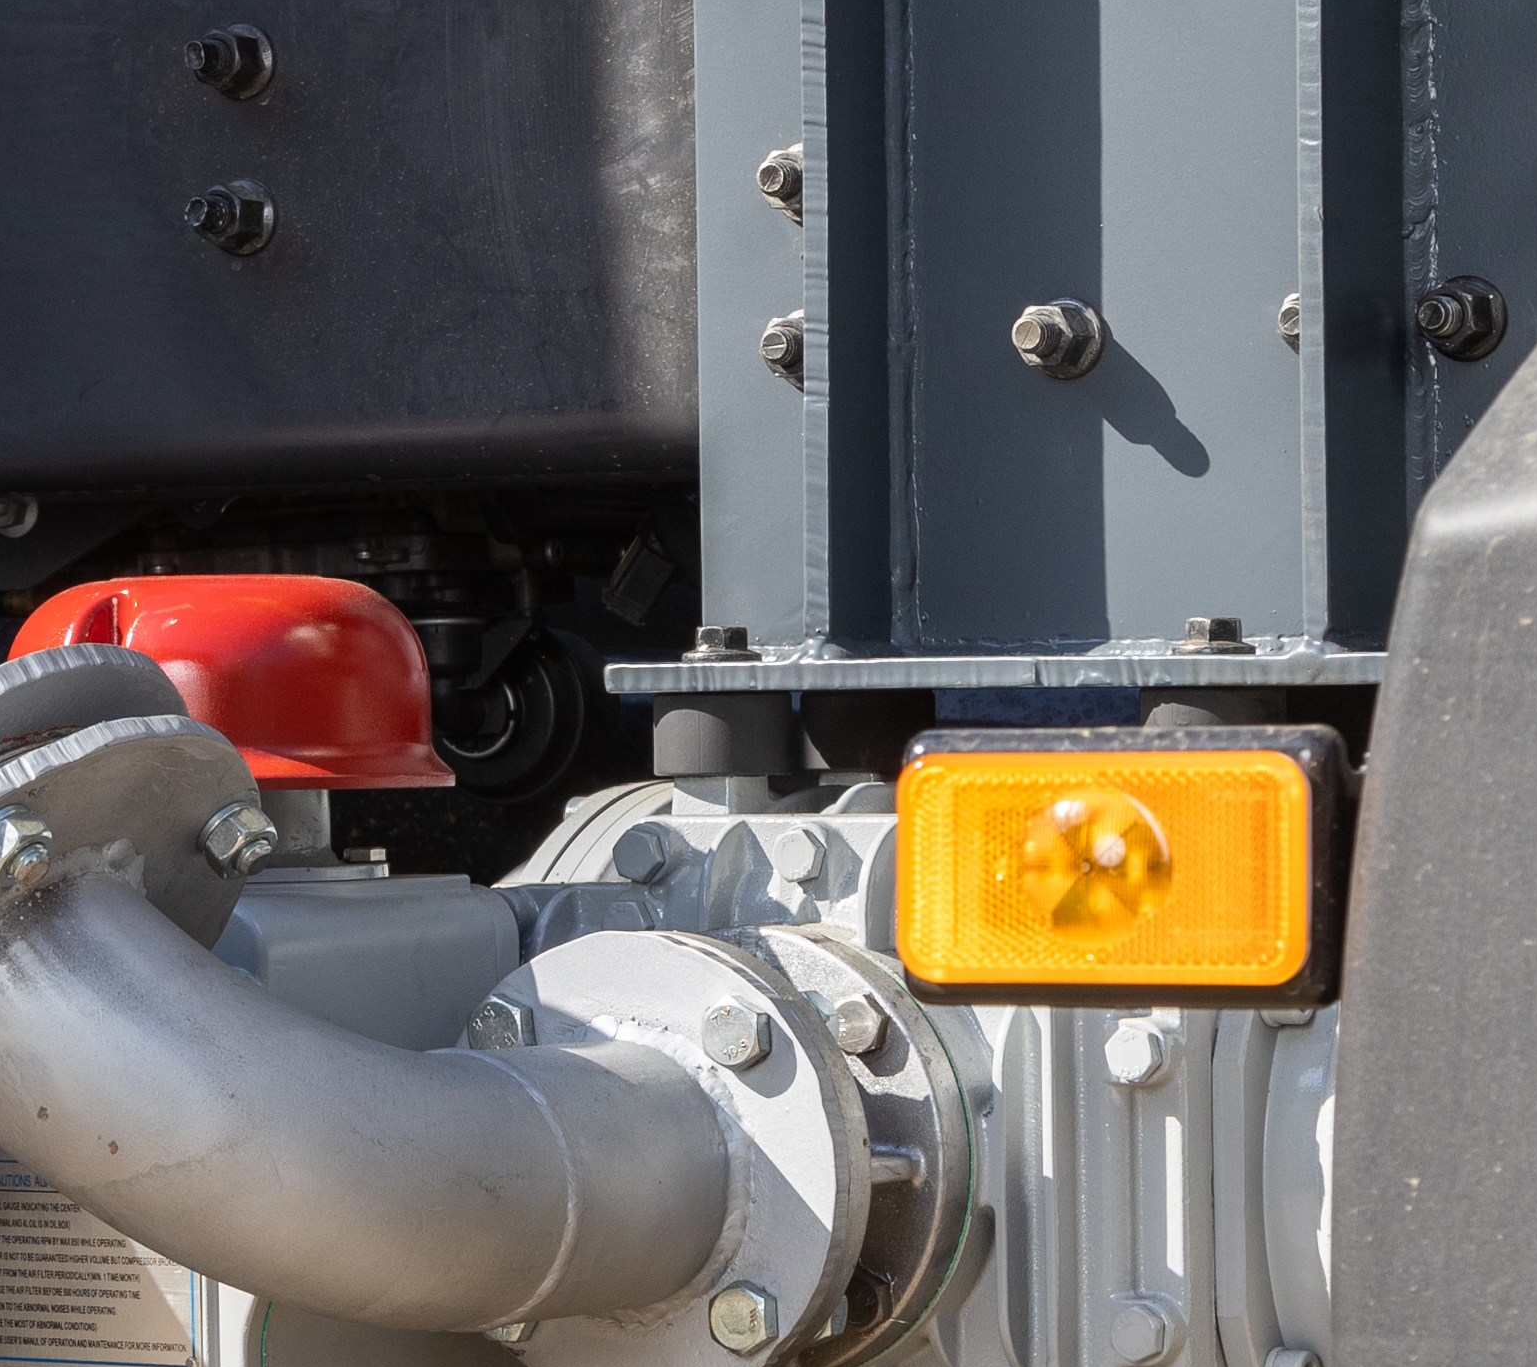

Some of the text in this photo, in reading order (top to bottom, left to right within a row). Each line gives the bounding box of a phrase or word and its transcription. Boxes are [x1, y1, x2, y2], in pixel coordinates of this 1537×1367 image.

[2, 1201, 20, 1211] GAUGE
[20, 1201, 49, 1212] INDICATING
[49, 1202, 59, 1212] THE
[1, 1234, 11, 1244] THE
[11, 1234, 40, 1245] OPERATING
[40, 1235, 51, 1245] RPM
[52, 1236, 59, 1246] BY
[80, 1237, 96, 1247] WHILE
[8, 1251, 20, 1261] NOT
[19, 1252, 27, 1262] TO
[27, 1252, 34, 1262] BE
[34, 1252, 68, 1263] GUARANTEED
[69, 1254, 88, 1264] HIGHER
[88, 1254, 110, 1265] VOLUME
[110, 1255, 120, 1265] BUT
[121, 1256, 156, 1267] COMPRESSOR
[2, 1267, 17, 1278] FROM
[17, 1268, 27, 1278] THE
[37, 1269, 54, 1279] FILTER
[5, 1284, 15, 1294] THE
[16, 1285, 24, 1295] AIR
[25, 1285, 42, 1295] FILTER
[42, 1286, 62, 1296] BEFORE
[72, 1287, 90, 1297] HOURS
[90, 1288, 97, 1298] OF
[98, 1288, 127, 1299] OPERATING
[5, 1301, 13, 1311] TO
[12, 1301, 23, 1311] THE
[23, 1302, 50, 1313] ABNORMAL
[51, 1303, 69, 1313] NOISES
[70, 1304, 86, 1314] WHILE
[3, 1318, 13, 1328] THE
[14, 1318, 28, 1329] MOST
[28, 1319, 36, 1329] OF
[36, 1319, 63, 1331] ABNORMAL
[39, 1336, 47, 1346] OF
[47, 1336, 76, 1347] OPERATION
[76, 1338, 87, 1348] AND
[87, 1338, 124, 1350] MAINTENANCE
[124, 1340, 134, 1350] FOR
[135, 1340, 151, 1351] MORE
